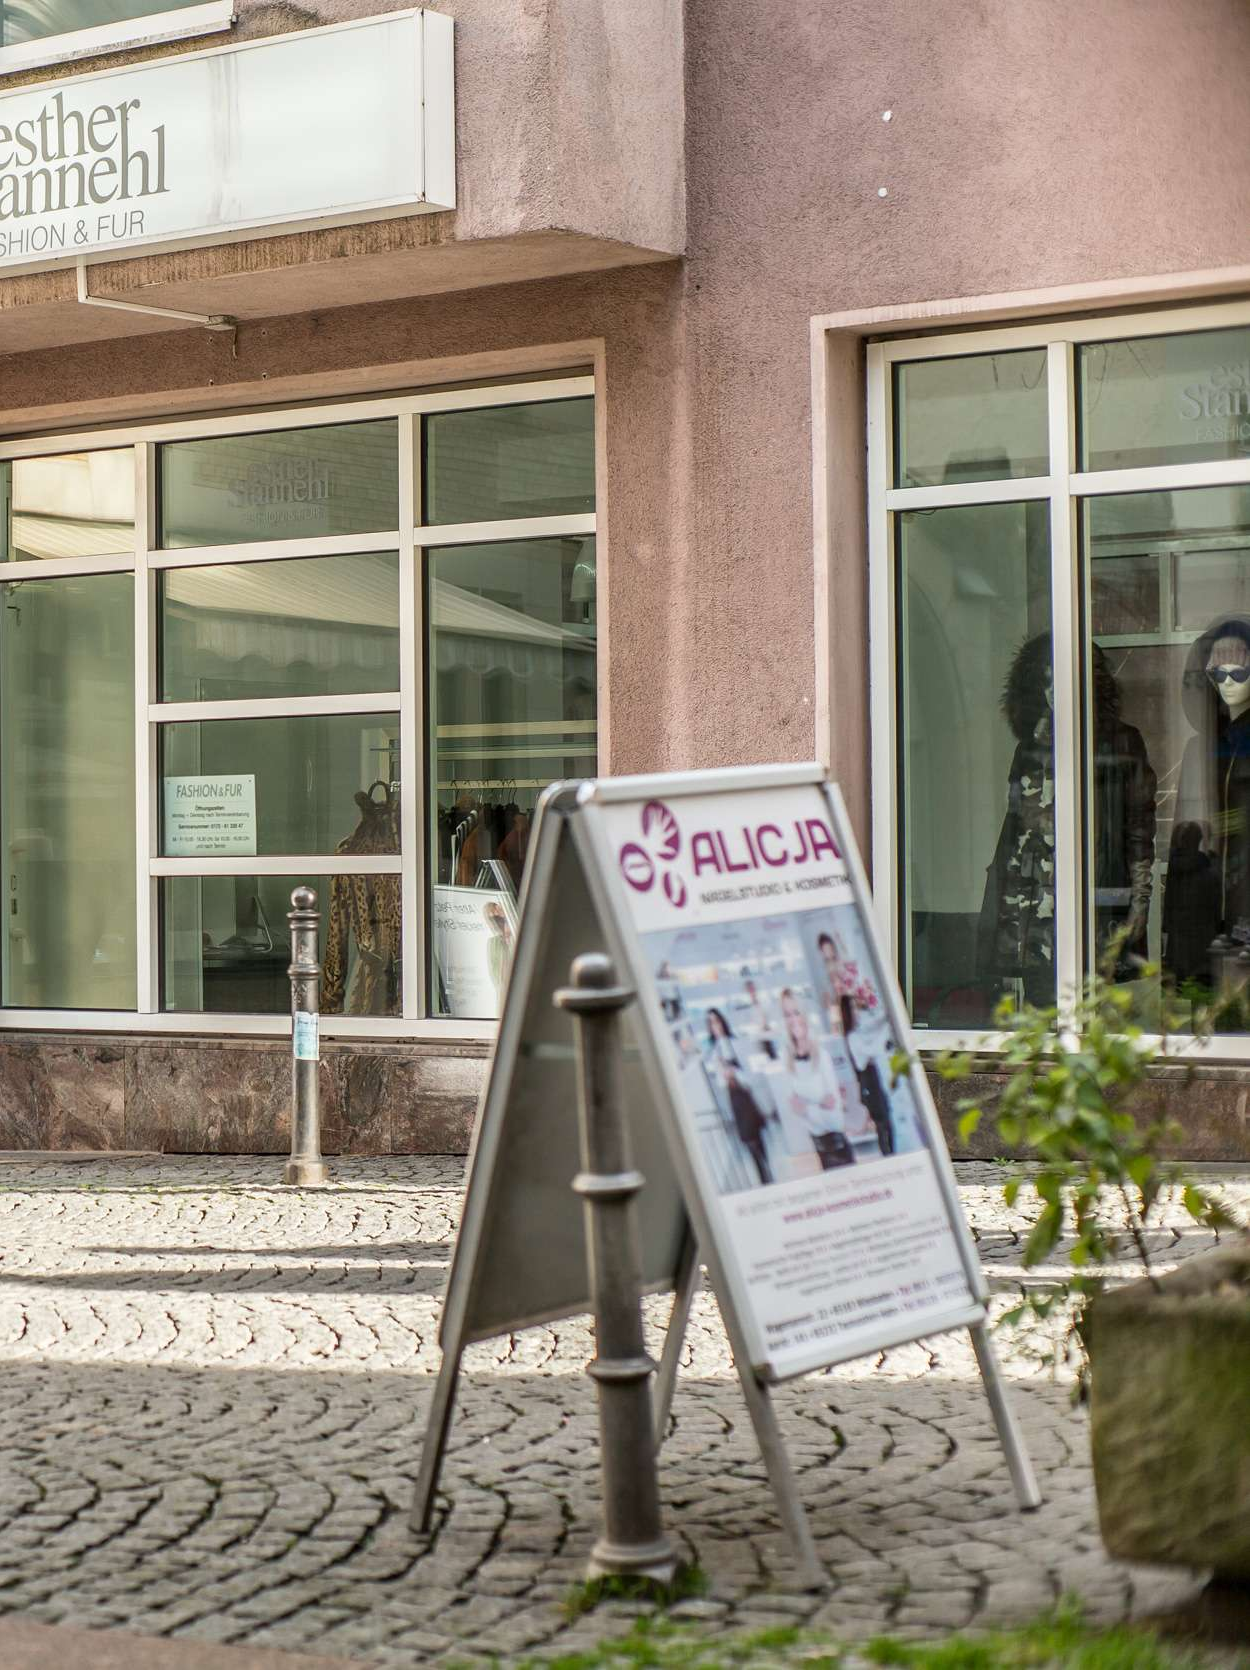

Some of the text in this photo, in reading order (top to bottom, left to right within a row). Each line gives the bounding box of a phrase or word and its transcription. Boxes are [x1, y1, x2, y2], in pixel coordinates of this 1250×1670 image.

[73, 219, 89, 245] &
[98, 210, 145, 241] FUR
[691, 818, 843, 877] ALICJA
